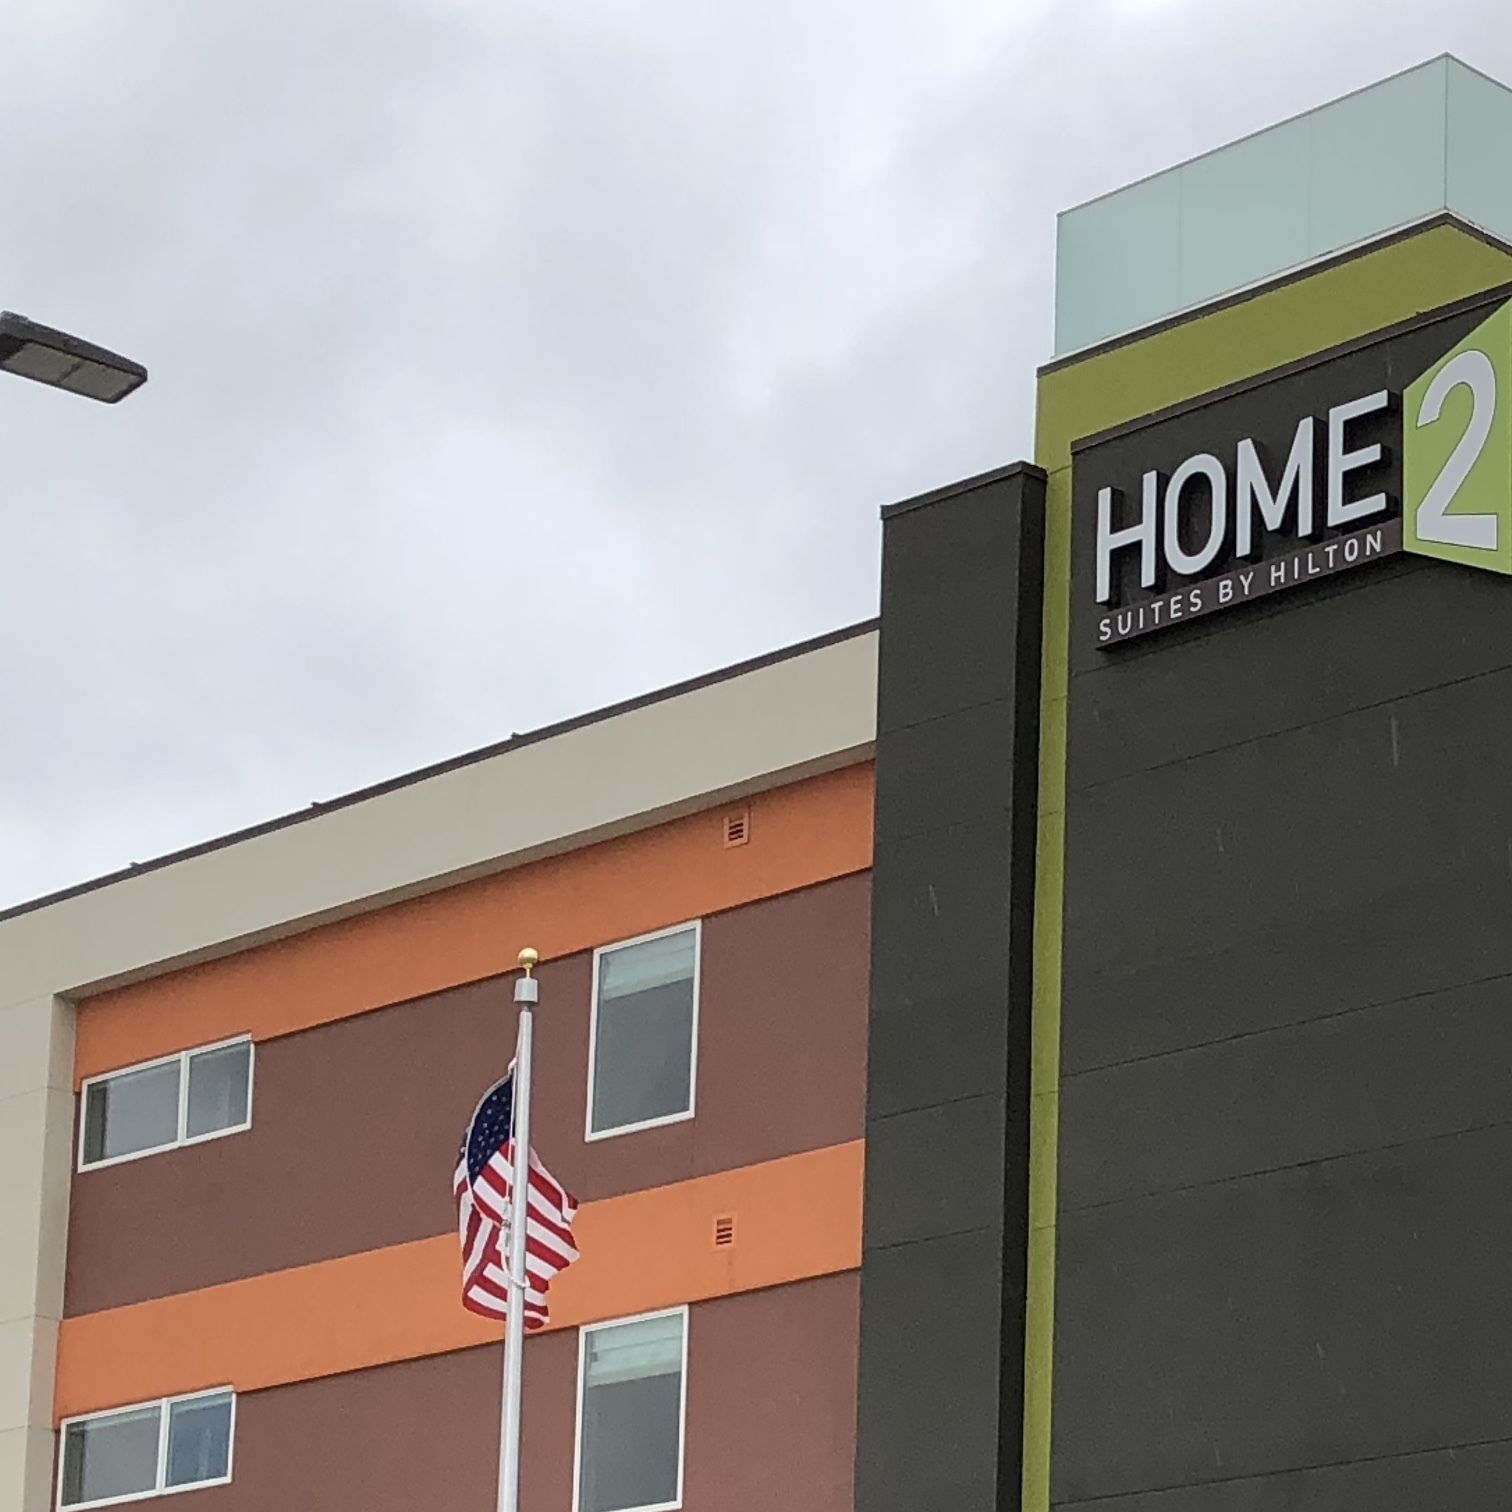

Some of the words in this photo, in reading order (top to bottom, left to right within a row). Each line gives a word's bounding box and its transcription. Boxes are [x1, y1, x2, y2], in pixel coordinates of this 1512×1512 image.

[1096, 389, 1389, 604] HOME
[1416, 350, 1498, 551] 2
[1098, 589, 1203, 641] SUITES
[1218, 572, 1254, 603] BY
[1270, 530, 1382, 587] HILTON
